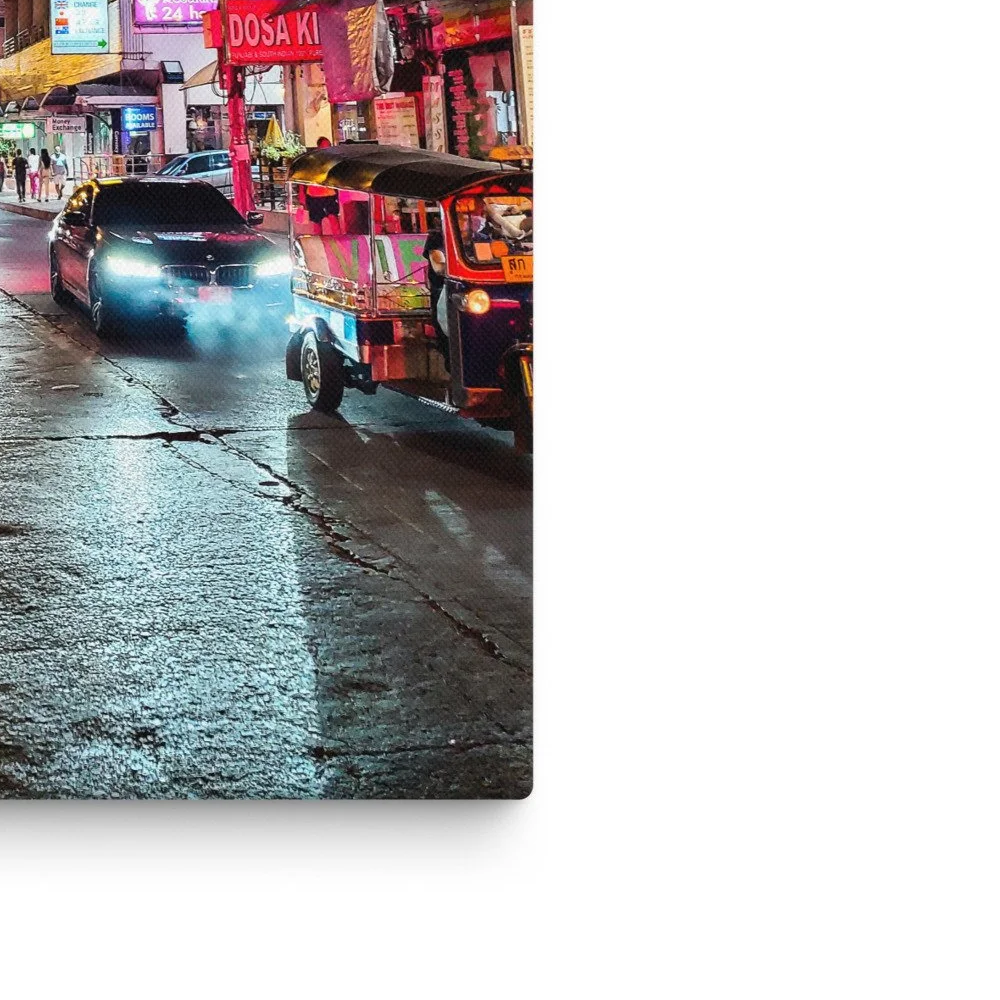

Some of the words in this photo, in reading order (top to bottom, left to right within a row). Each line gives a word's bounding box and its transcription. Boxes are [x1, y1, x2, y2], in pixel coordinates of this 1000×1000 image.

[161, 6, 183, 20] 24
[229, 12, 291, 47] DOSA
[126, 113, 155, 121] ROOMS
[52, 124, 82, 132] Exchange
